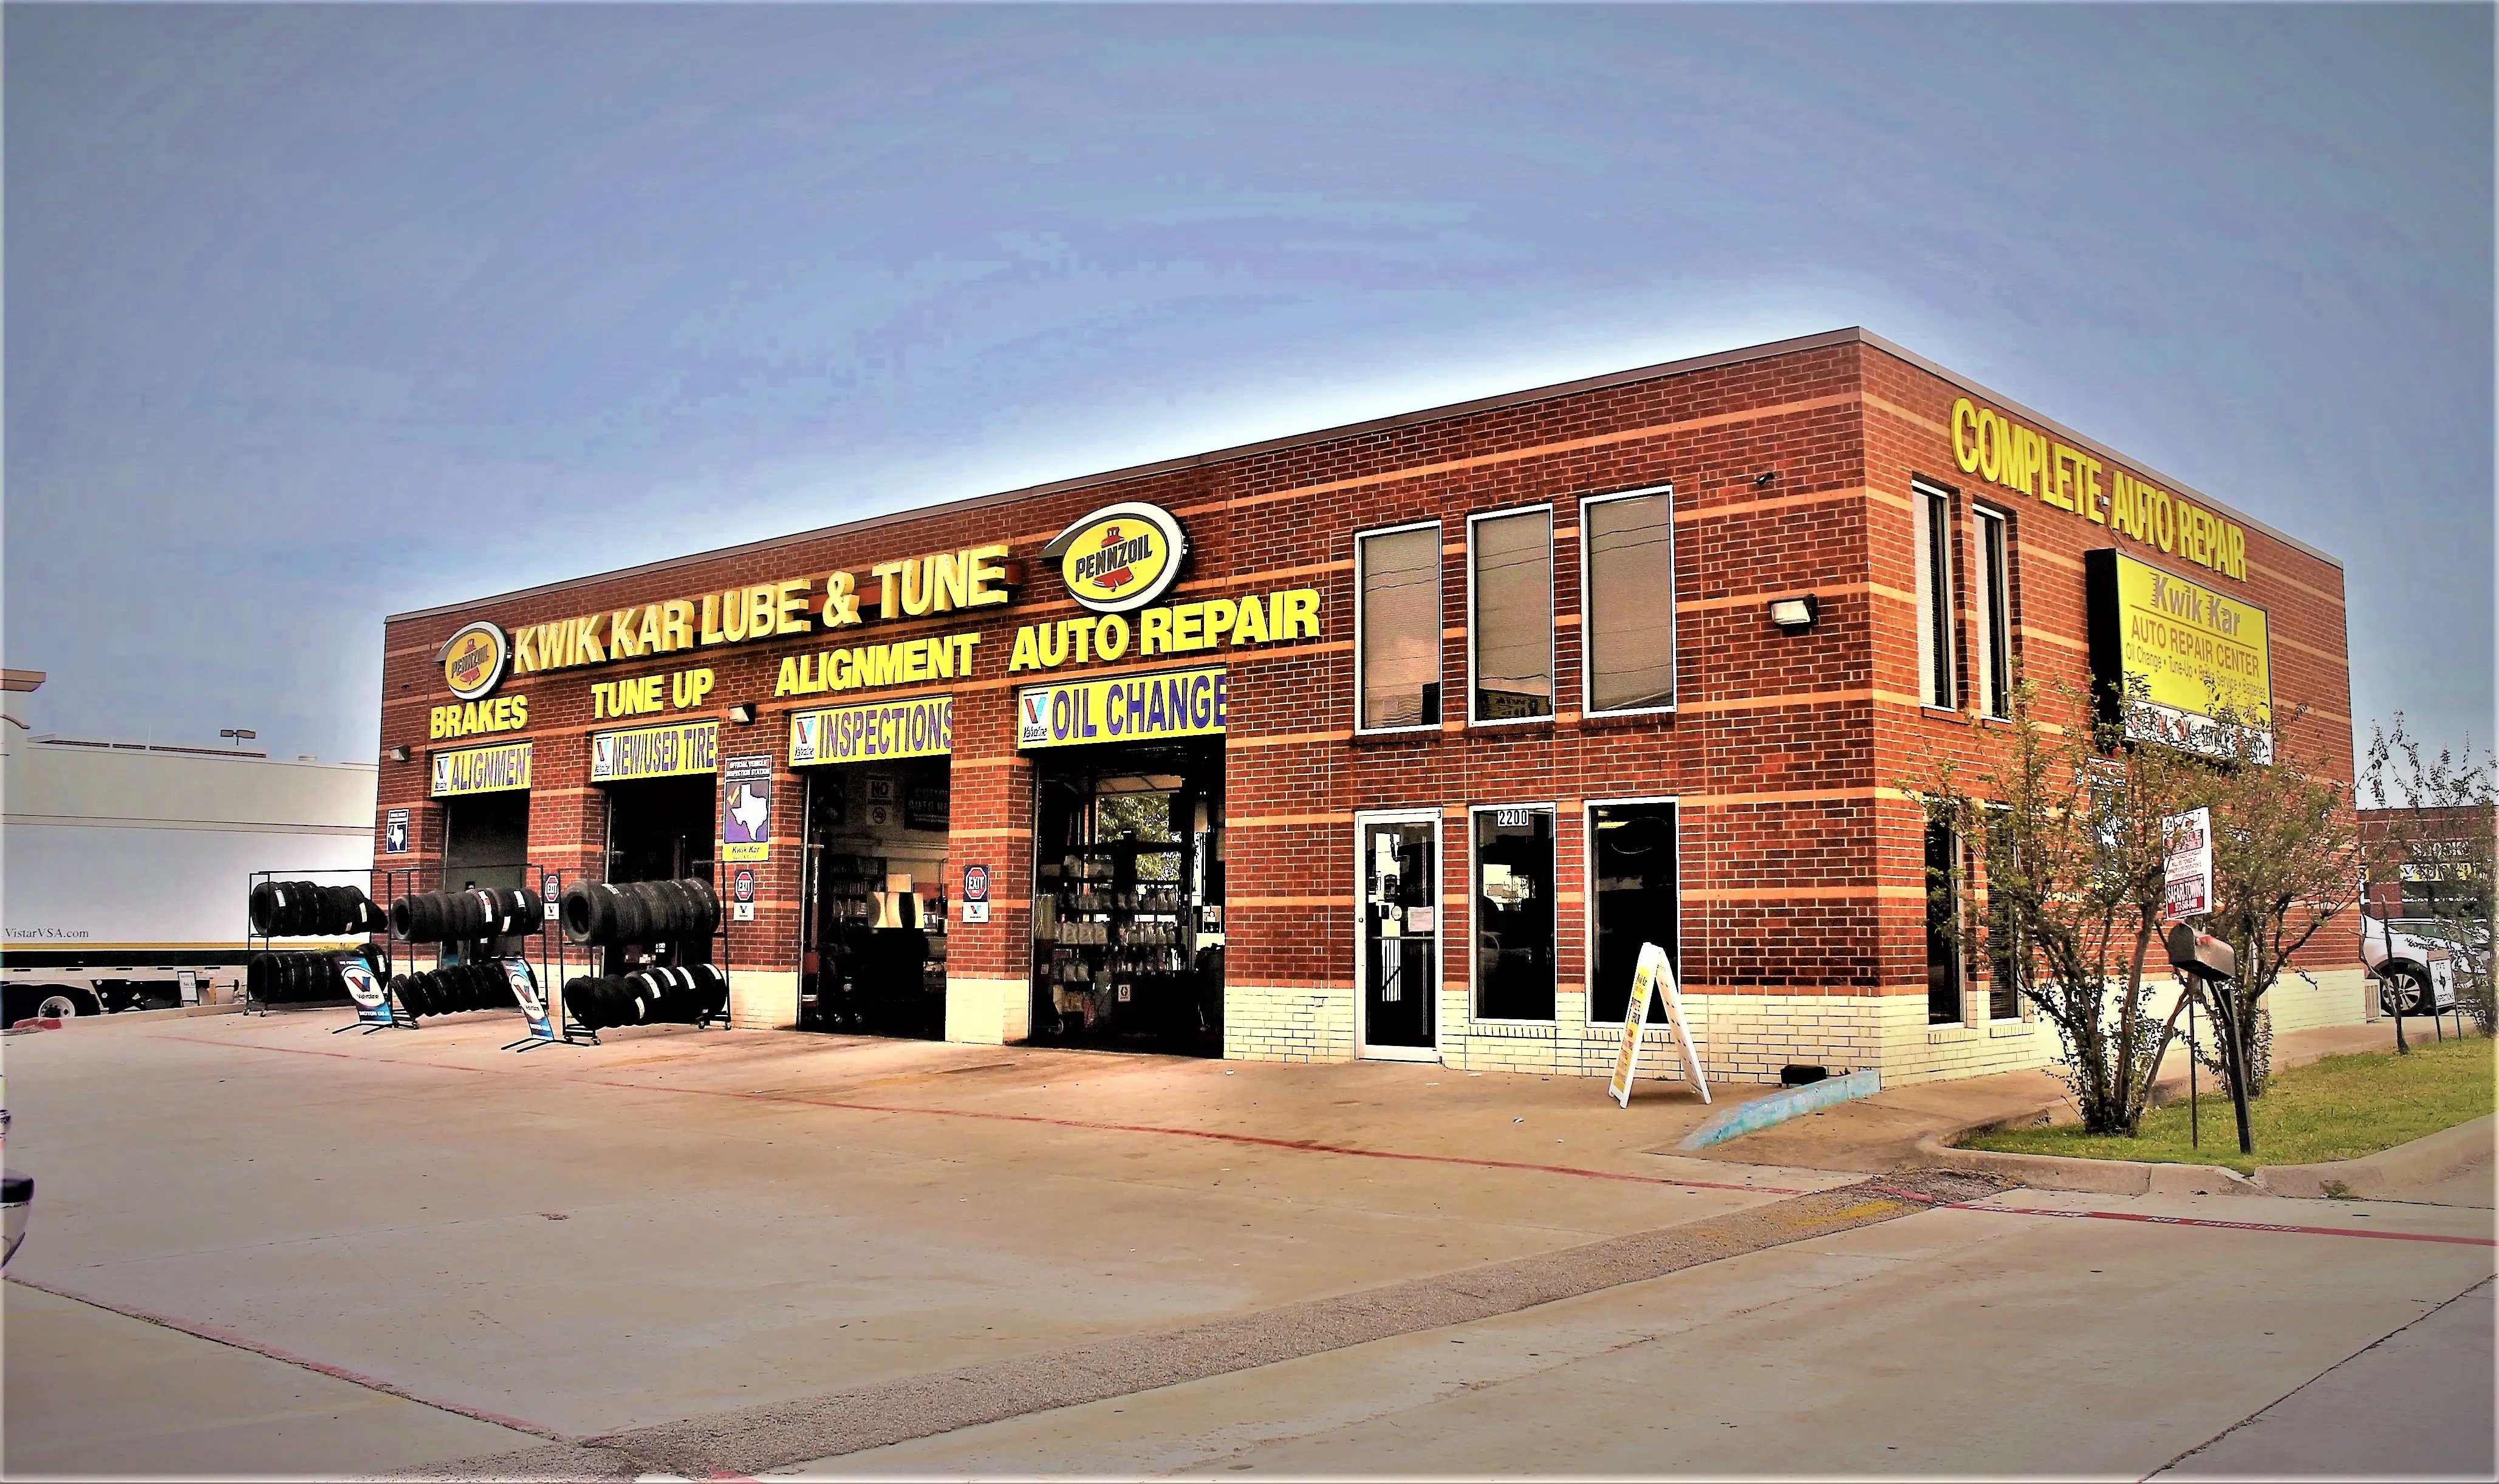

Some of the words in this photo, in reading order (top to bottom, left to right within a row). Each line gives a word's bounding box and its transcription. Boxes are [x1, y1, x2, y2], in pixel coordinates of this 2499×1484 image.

[1952, 397, 2105, 525] COMPLETE
[2111, 470, 2173, 553] AUTO
[2176, 499, 2246, 583] REPAIR
[1075, 534, 1153, 583] PENNZOIL
[514, 614, 606, 674] KWIK
[610, 599, 694, 660] KAR
[701, 578, 812, 645] LUBE
[822, 571, 863, 627] &
[872, 545, 1008, 619] TUNE
[1007, 614, 1130, 672] AUTO
[1140, 588, 1321, 656] REPAIR
[2150, 572, 2203, 624] Kwik
[2206, 595, 2240, 636] Kar
[774, 632, 981, 697] ALIGNMENT
[2132, 615, 2166, 649] AUTO
[2170, 627, 2213, 664] REPAIR
[2216, 644, 2260, 679] CENTER
[2137, 646, 2162, 673] Change
[430, 694, 528, 739] BRAKES
[591, 674, 665, 719] TUNE
[672, 667, 715, 710] UP
[1052, 688, 1097, 741] OIL
[1106, 674, 1227, 736] CHANGE
[684, 726, 719, 770] TIRE
[1499, 810, 1527, 825] 2200
[968, 876, 985, 890] EXIT
[2193, 1220, 2301, 1232] PARKING
